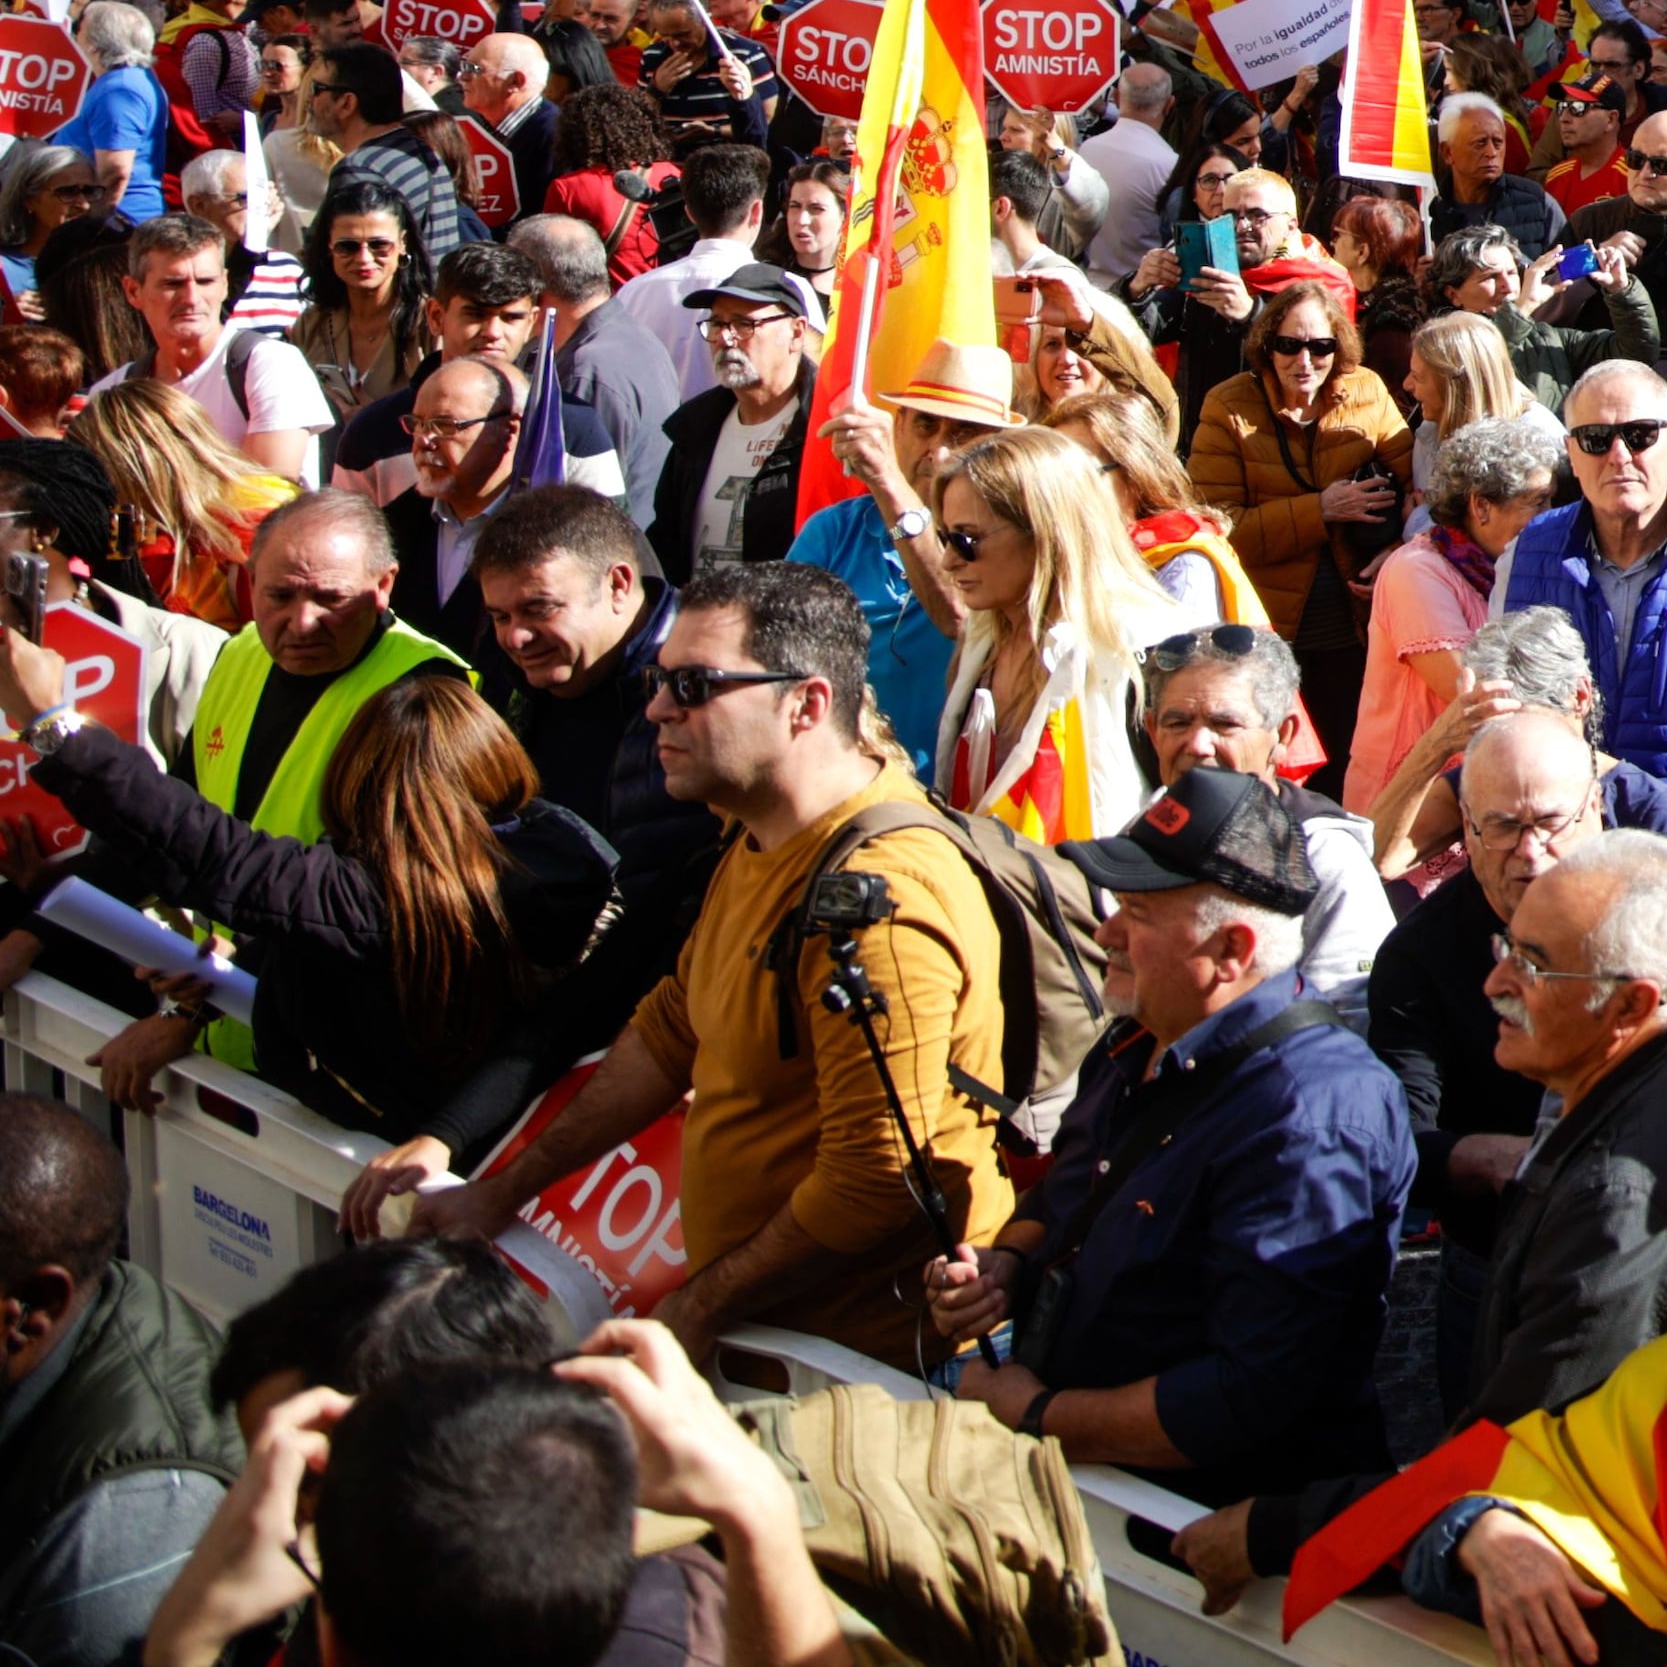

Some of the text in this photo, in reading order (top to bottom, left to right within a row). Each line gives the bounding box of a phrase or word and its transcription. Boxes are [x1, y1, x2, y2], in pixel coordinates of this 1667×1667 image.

[794, 25, 872, 72] STO
[994, 8, 1103, 51] STOP
[1234, 40, 1258, 56] Por
[1260, 33, 1273, 46] la
[1274, 3, 1329, 41] igualdad
[1245, 10, 1351, 70] todos los españoles
[0, 53, 77, 92] TOP
[793, 64, 867, 94] SÁNCH
[994, 52, 1102, 77] AMNISTÍA
[0, 87, 64, 116] NISTÍA
[570, 1141, 688, 1278] TOP
